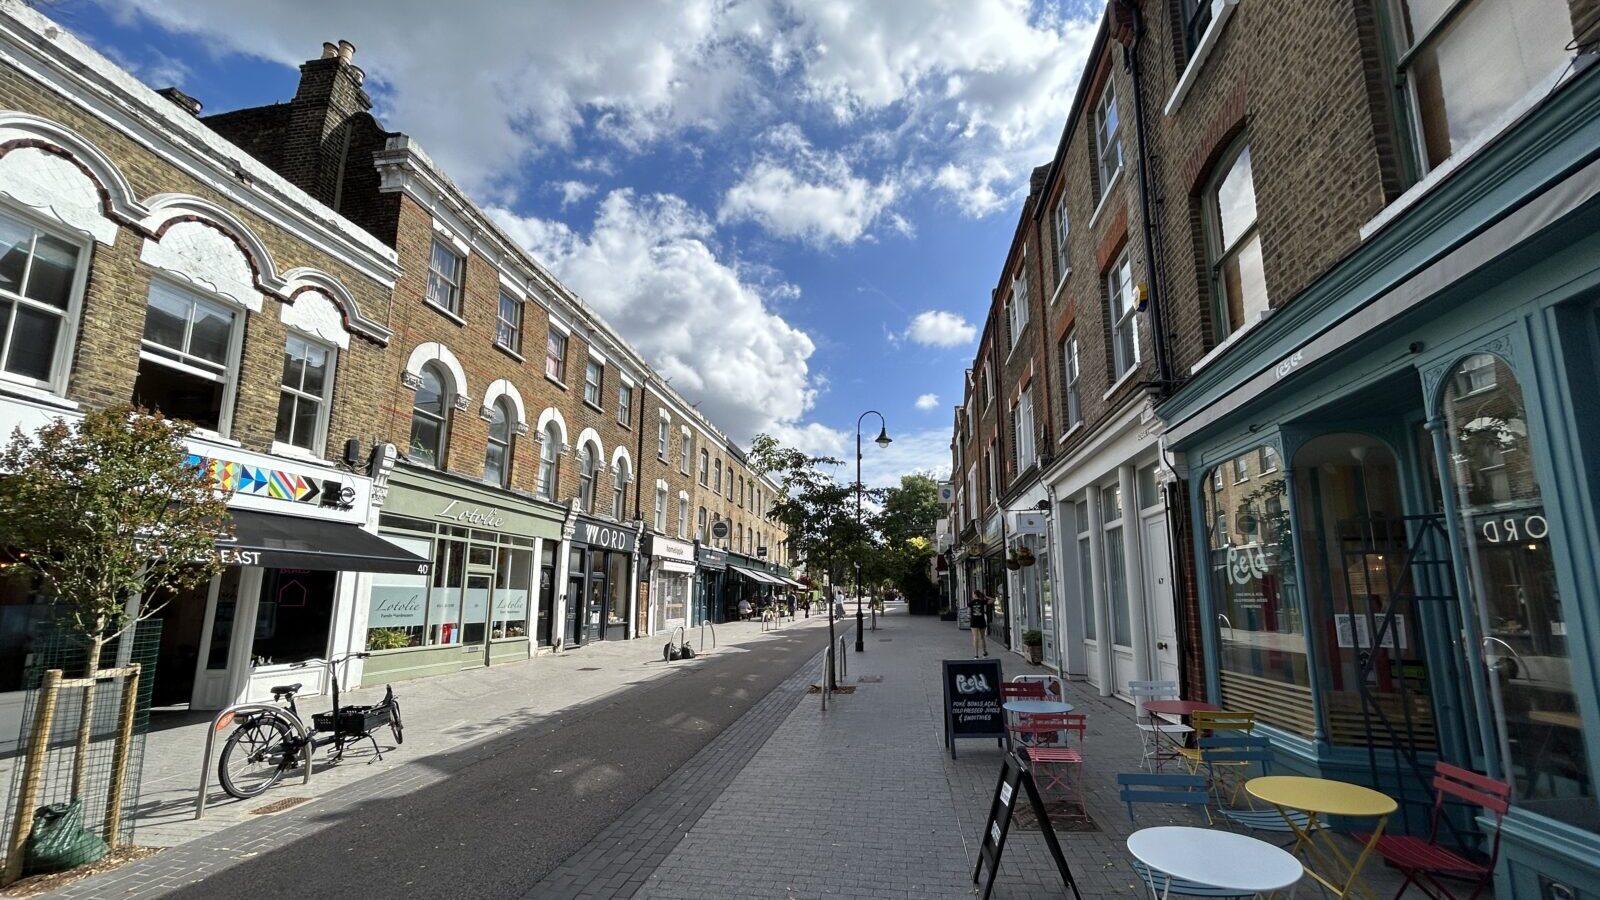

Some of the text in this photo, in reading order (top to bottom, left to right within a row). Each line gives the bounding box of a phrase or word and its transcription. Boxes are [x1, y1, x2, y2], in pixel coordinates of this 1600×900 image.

[434, 499, 505, 528] Lotolie
[585, 523, 626, 550] WORD
[220, 549, 262, 565] EAST
[1227, 546, 1269, 585] Peeld
[417, 564, 428, 575] 40
[376, 594, 421, 611] Lotolie
[956, 673, 991, 693] Peeld
